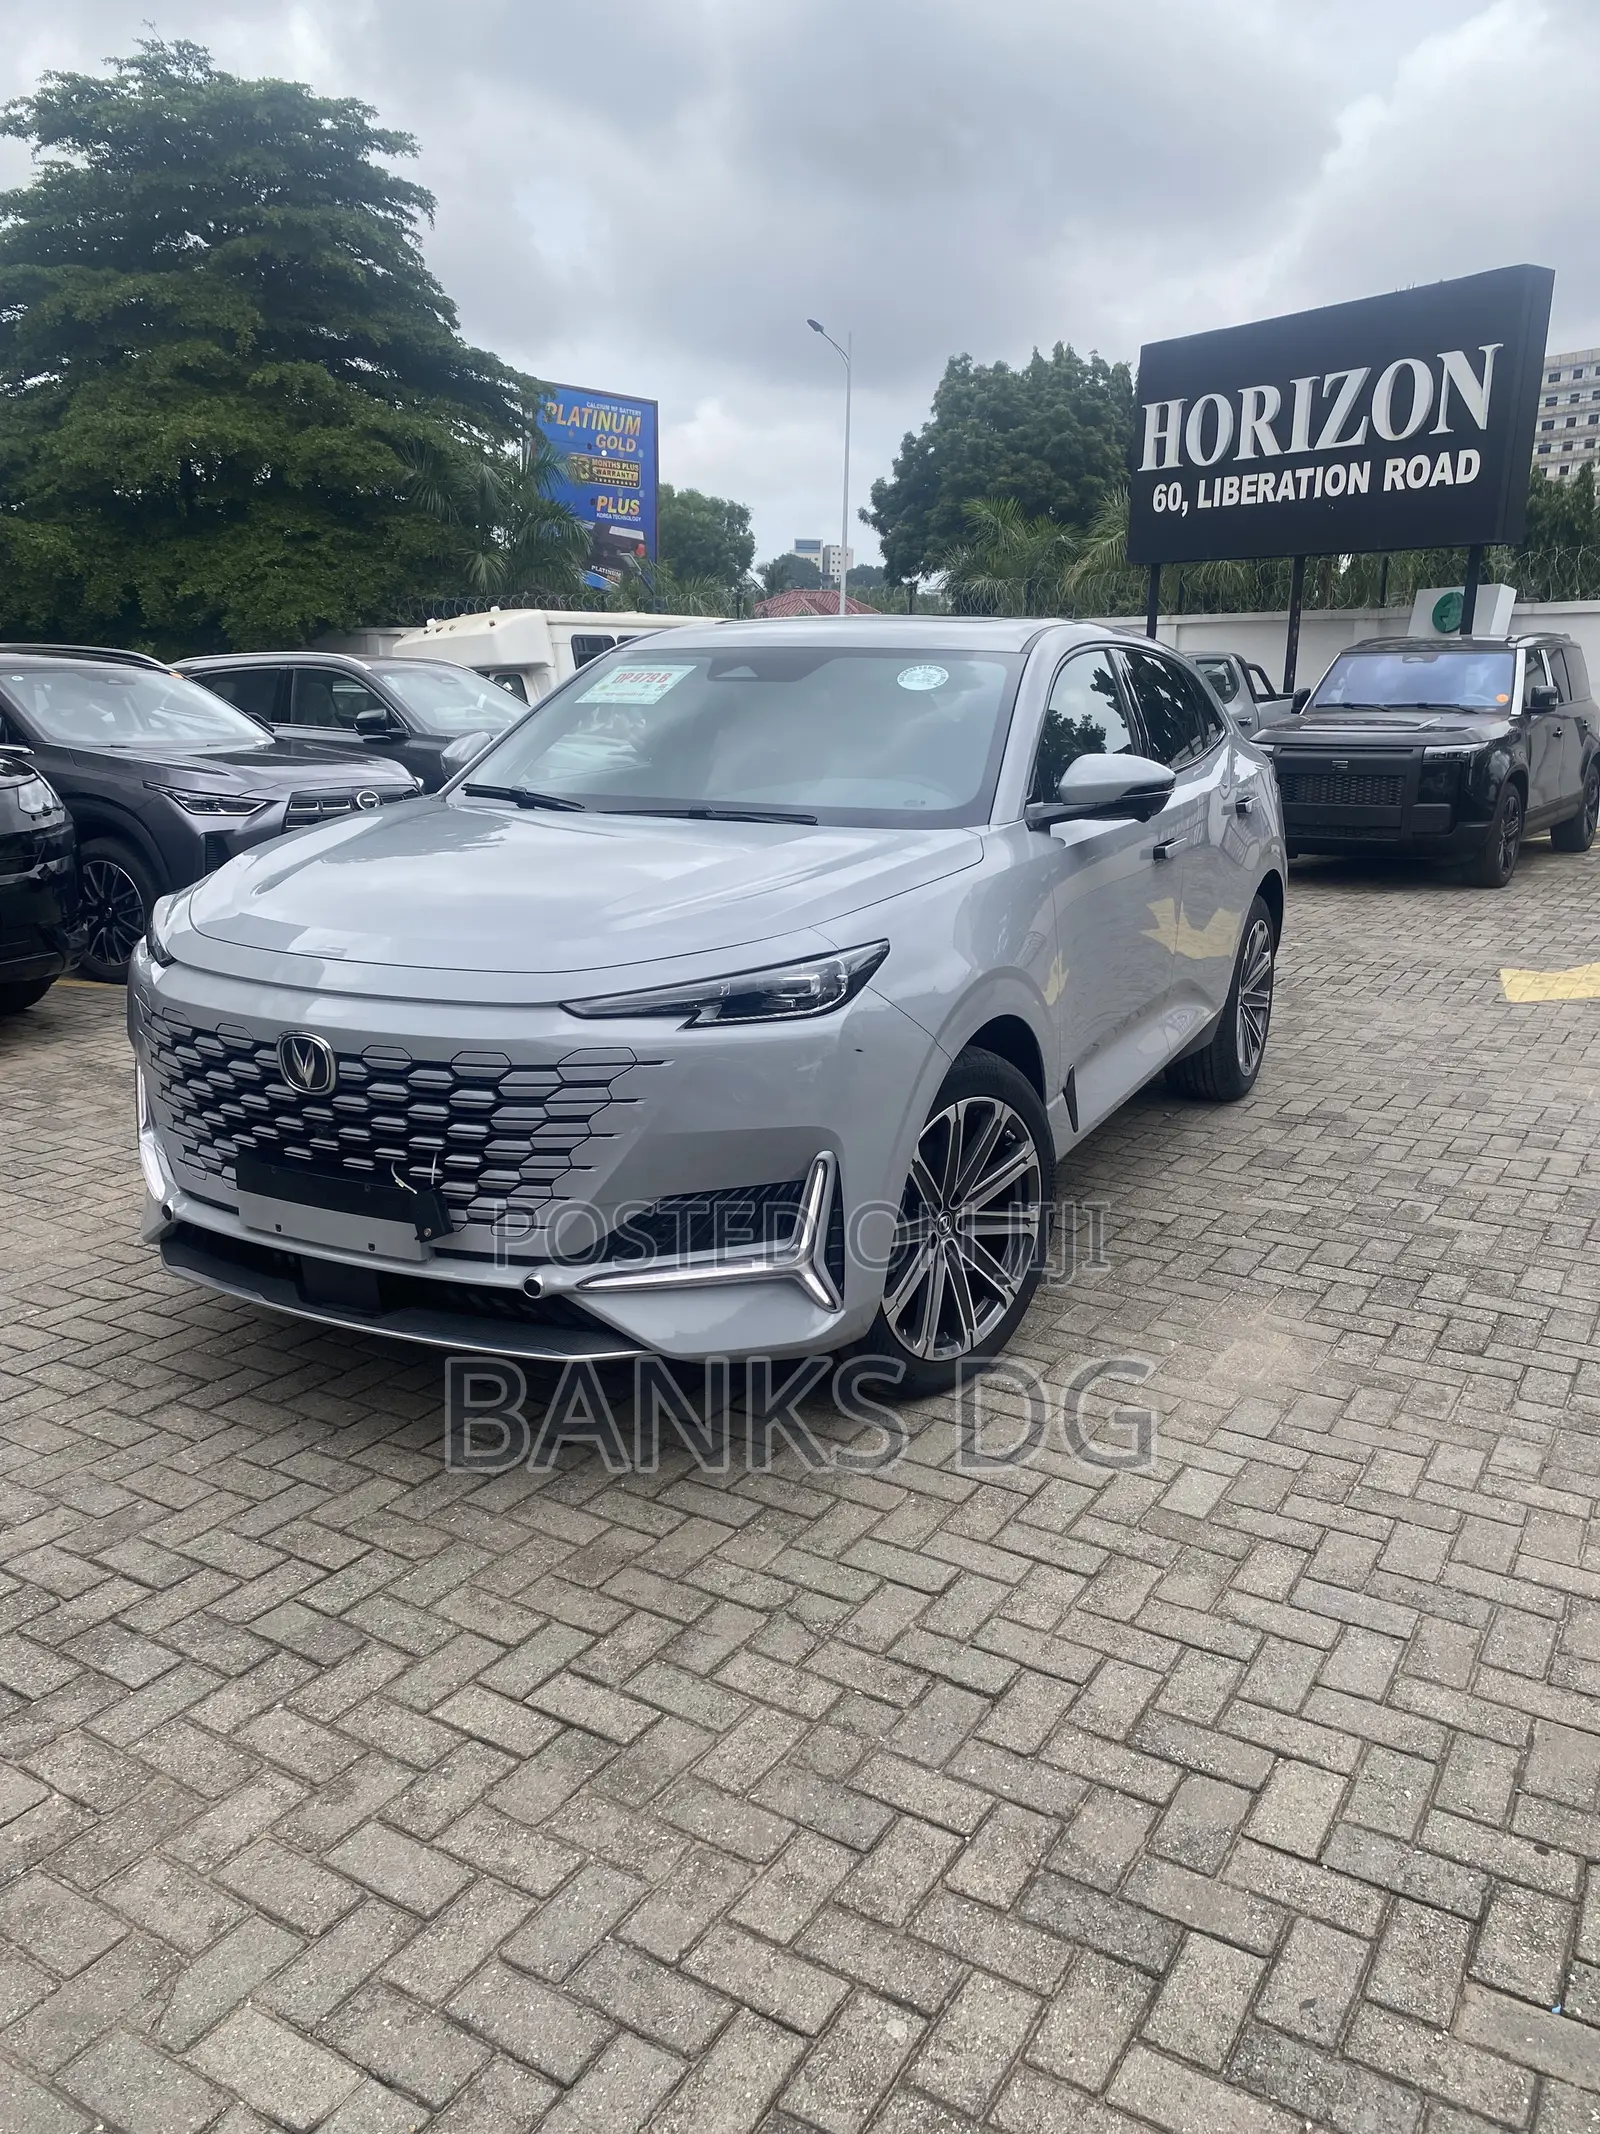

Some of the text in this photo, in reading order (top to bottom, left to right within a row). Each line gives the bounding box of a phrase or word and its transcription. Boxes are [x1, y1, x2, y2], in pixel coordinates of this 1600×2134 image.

[586, 402, 611, 411] CALCIUM
[619, 407, 642, 416] BATTERY
[1137, 343, 1503, 472] HORIZON
[544, 402, 642, 436] PLATINUM
[595, 433, 637, 453] GOLD
[592, 458, 639, 471] MONTHS PLUS
[596, 468, 635, 479] WARRANTY
[1152, 448, 1481, 518] 60, LIBERATION ROAD
[596, 495, 640, 516] PLUS
[613, 514, 642, 522] TECHNOLOGY
[591, 565, 621, 576] PLATINUM
